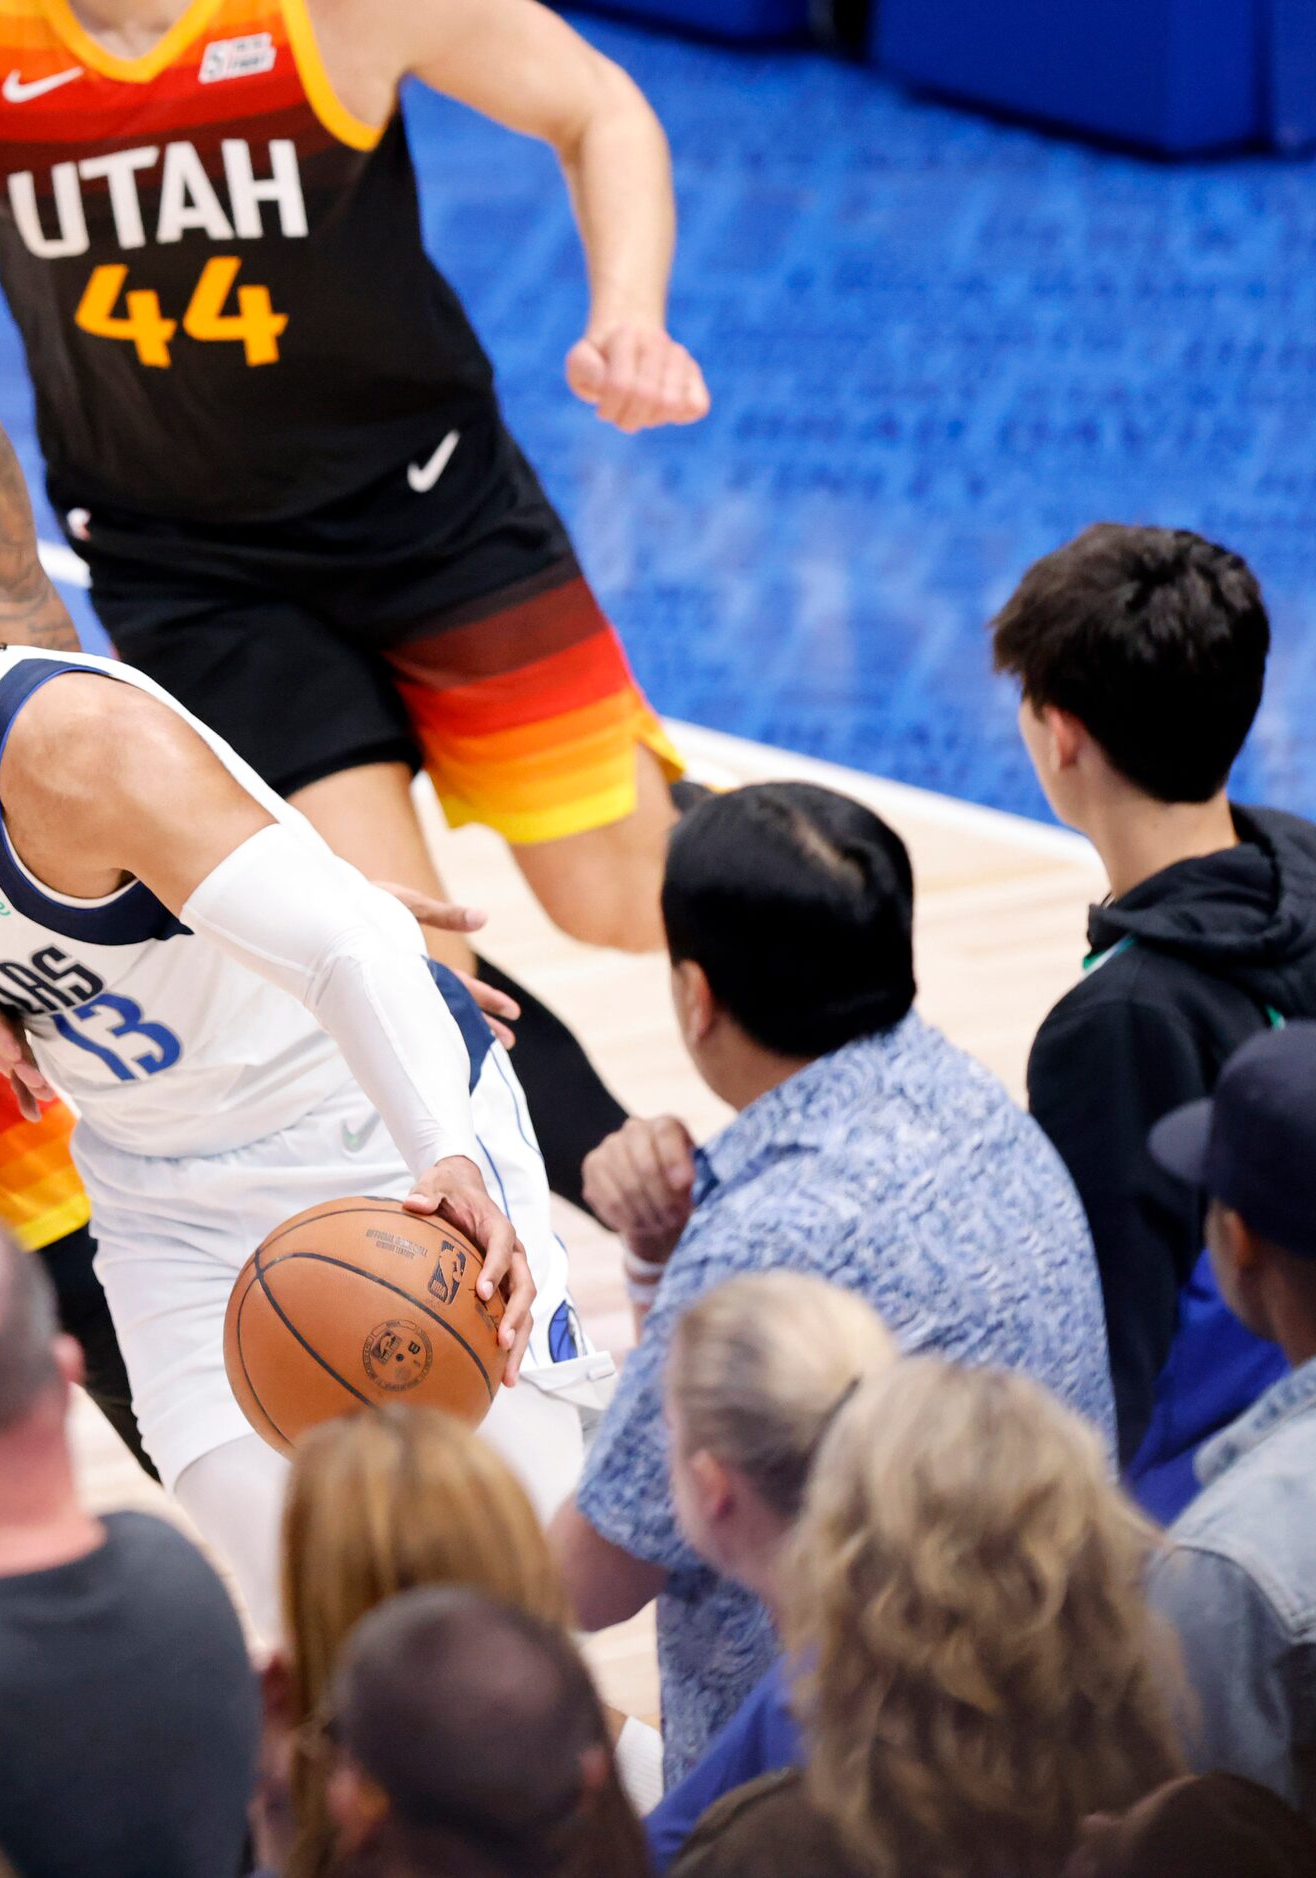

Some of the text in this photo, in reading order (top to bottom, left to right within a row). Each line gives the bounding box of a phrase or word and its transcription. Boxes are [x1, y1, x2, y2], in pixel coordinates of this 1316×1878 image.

[7, 138, 309, 259] UTAH
[74, 256, 289, 368] 44
[50, 992, 181, 1081] 13
